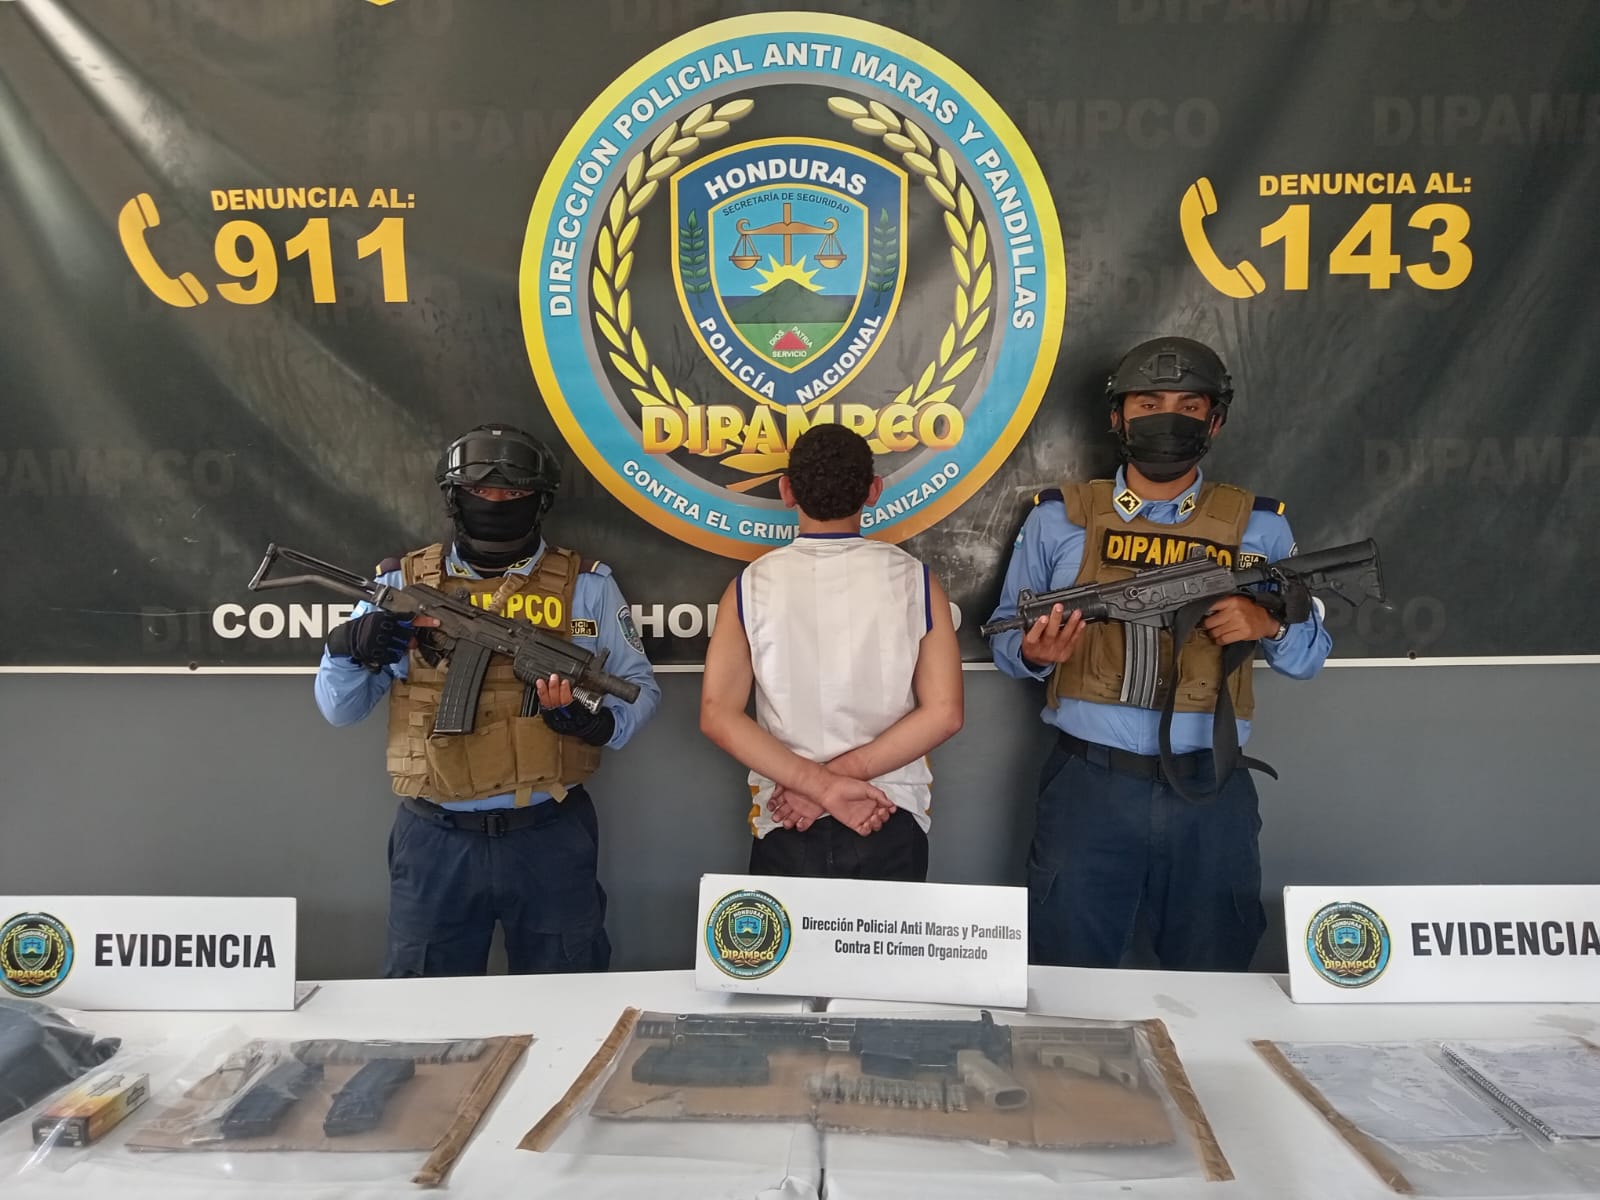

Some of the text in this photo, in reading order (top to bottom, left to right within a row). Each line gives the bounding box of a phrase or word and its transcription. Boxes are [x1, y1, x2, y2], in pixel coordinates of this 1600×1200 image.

[549, 42, 1035, 330] DIRECCIÓN POLICIAL ANTI MARAS Y PANDILLAS
[704, 158, 867, 200] HONDURAS
[1259, 173, 1472, 196] DENUNCIA AL:
[211, 188, 415, 211] DENUNCIA AL:
[722, 192, 850, 217] SECRETARÍA DE SEGURIDAD
[1260, 203, 1473, 291] 143
[214, 217, 409, 305] 911
[768, 329, 785, 347] DIOS
[791, 326, 814, 348] PATRIA
[700, 315, 881, 403] POLICÍA NACIONAL
[772, 350, 807, 358] SERVICIO
[622, 460, 960, 542] CONTRA EL CRIM GANIZADO
[802, 916, 1022, 941] Dirección Policial Anti Maras y Pandillas
[1411, 921, 1600, 956] EVIDENCIA
[94, 933, 276, 969] EVIDENCIA
[721, 950, 775, 960] DIPAMPCO
[834, 939, 988, 960] Contra El Crímen Organizado
